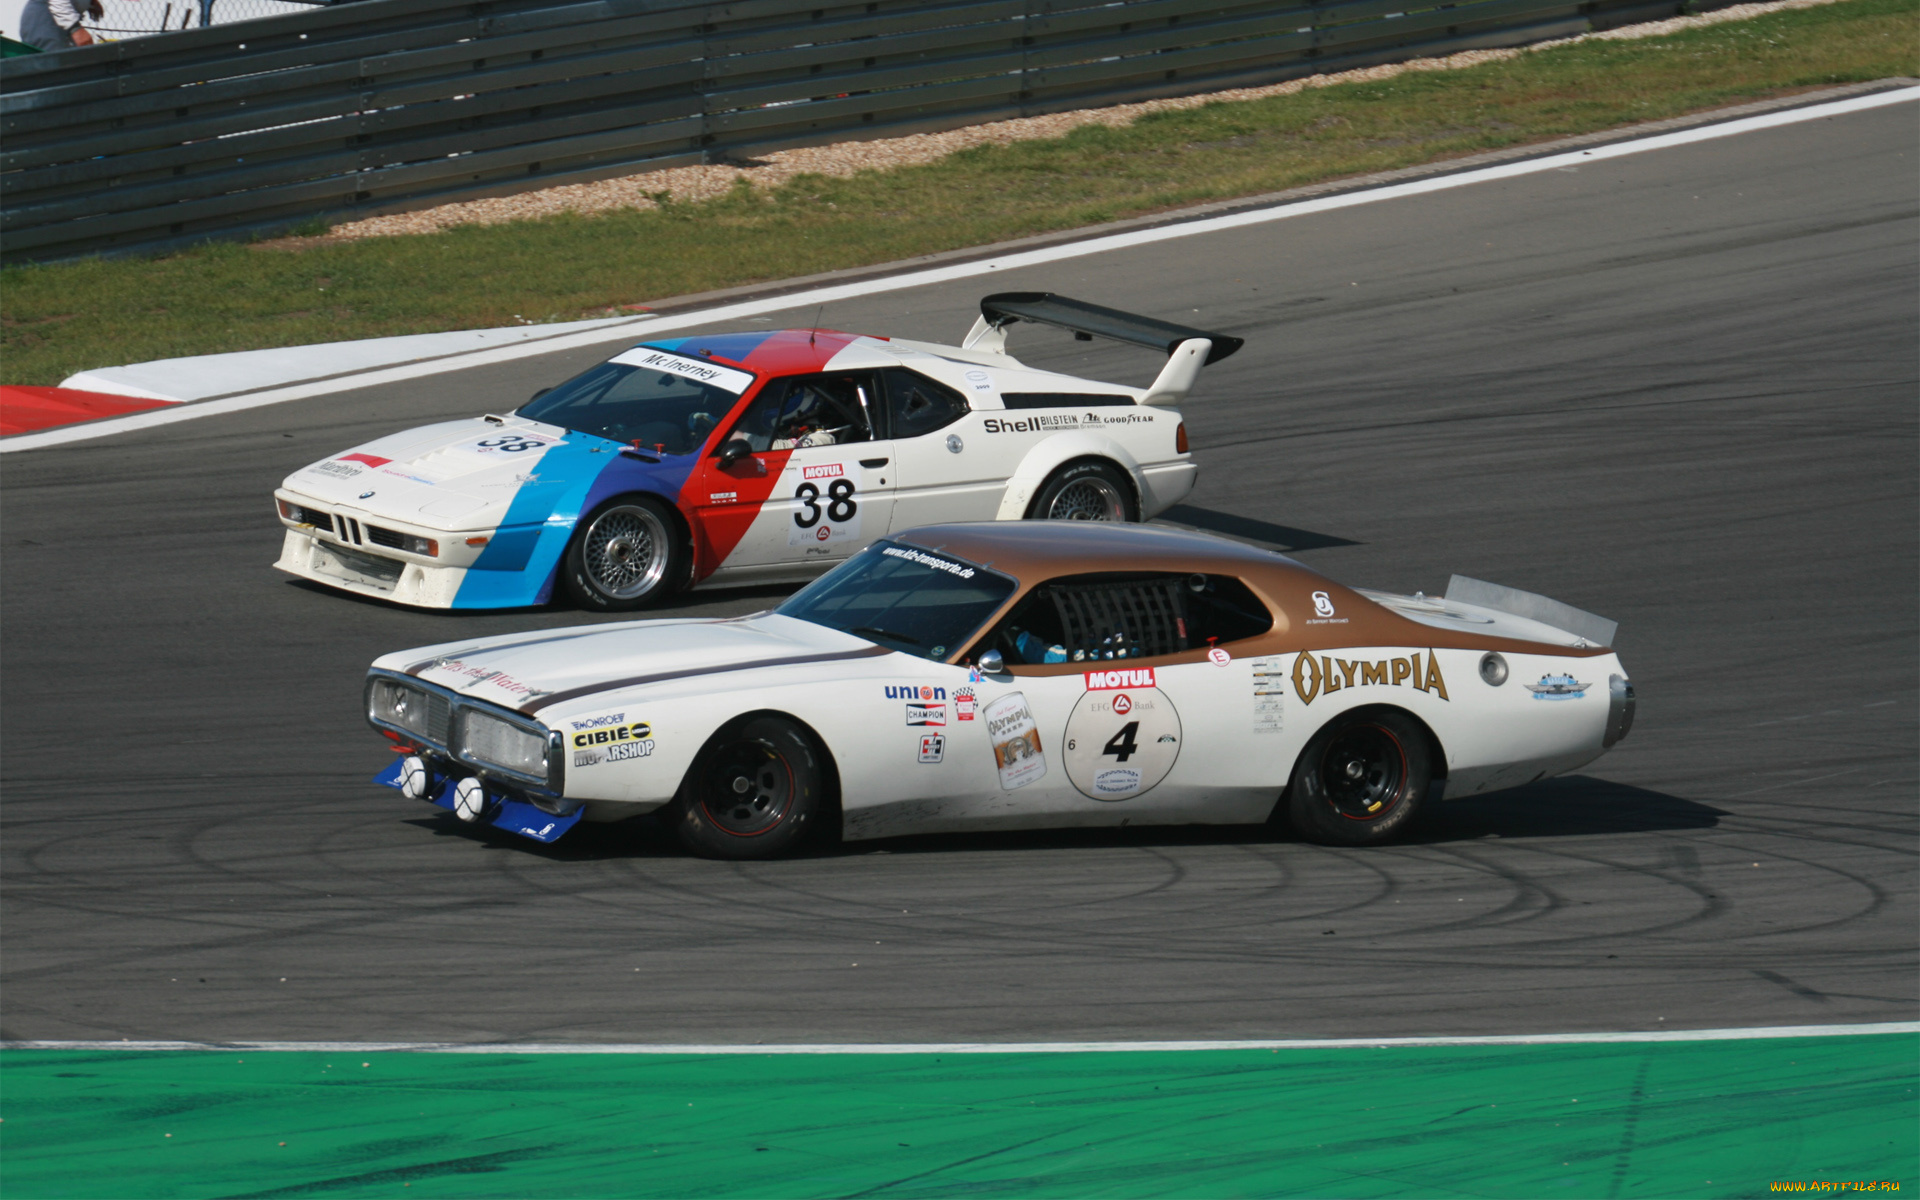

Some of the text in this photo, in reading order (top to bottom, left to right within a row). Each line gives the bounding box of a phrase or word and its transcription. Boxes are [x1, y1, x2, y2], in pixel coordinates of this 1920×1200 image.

[984, 417, 1040, 433] Shell
[1041, 415, 1078, 426] BILSTEIN
[1104, 414, 1154, 425] GOODYEAR
[477, 436, 546, 452] 38
[805, 465, 842, 478] MOTUL
[794, 478, 857, 529] 38
[1089, 669, 1154, 689] MOTUL
[1291, 648, 1450, 706] OLYMPIA
[1091, 701, 1155, 712] EFG Bank
[578, 713, 623, 729] MONROE
[989, 706, 1032, 736] OLYMPIA
[1068, 739, 1076, 750] 6
[1102, 721, 1140, 762] 4
